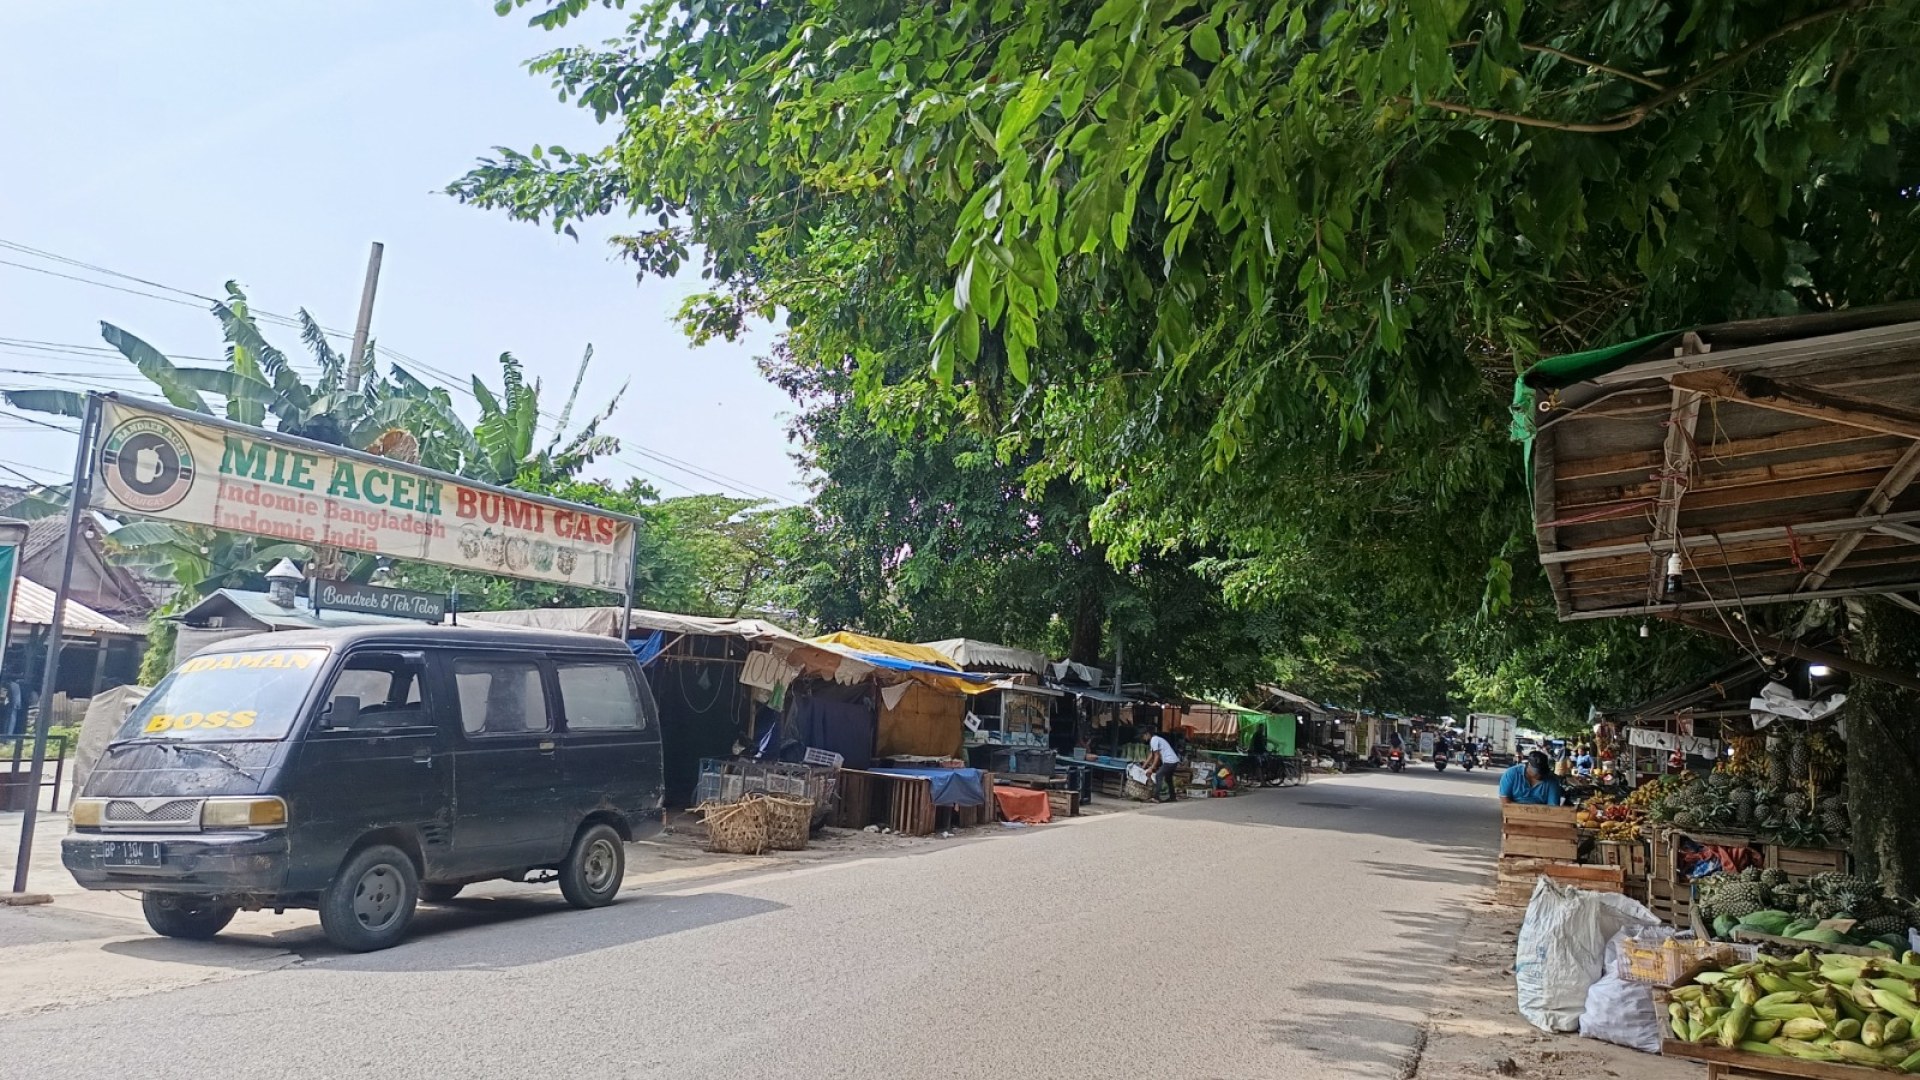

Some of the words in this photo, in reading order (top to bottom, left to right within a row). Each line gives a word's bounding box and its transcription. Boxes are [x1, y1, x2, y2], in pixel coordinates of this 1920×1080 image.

[116, 421, 164, 442] BANDREK
[166, 431, 187, 456] ACEH
[219, 436, 318, 491] MIE
[327, 461, 443, 516] ACEH
[456, 486, 545, 534] BUMI
[554, 510, 616, 546] GAS
[219, 478, 318, 517] Indomie
[323, 499, 446, 540] Bangladesh
[215, 504, 315, 542] Indomie
[323, 525, 378, 552] India
[323, 585, 378, 608] Bandrek
[380, 594, 389, 609] &
[389, 593, 411, 612] Teh
[411, 596, 440, 616] Telor
[181, 653, 313, 674] IDAMAN
[145, 710, 257, 732] BOSS
[105, 842, 116, 858] BP
[152, 842, 160, 859] D
